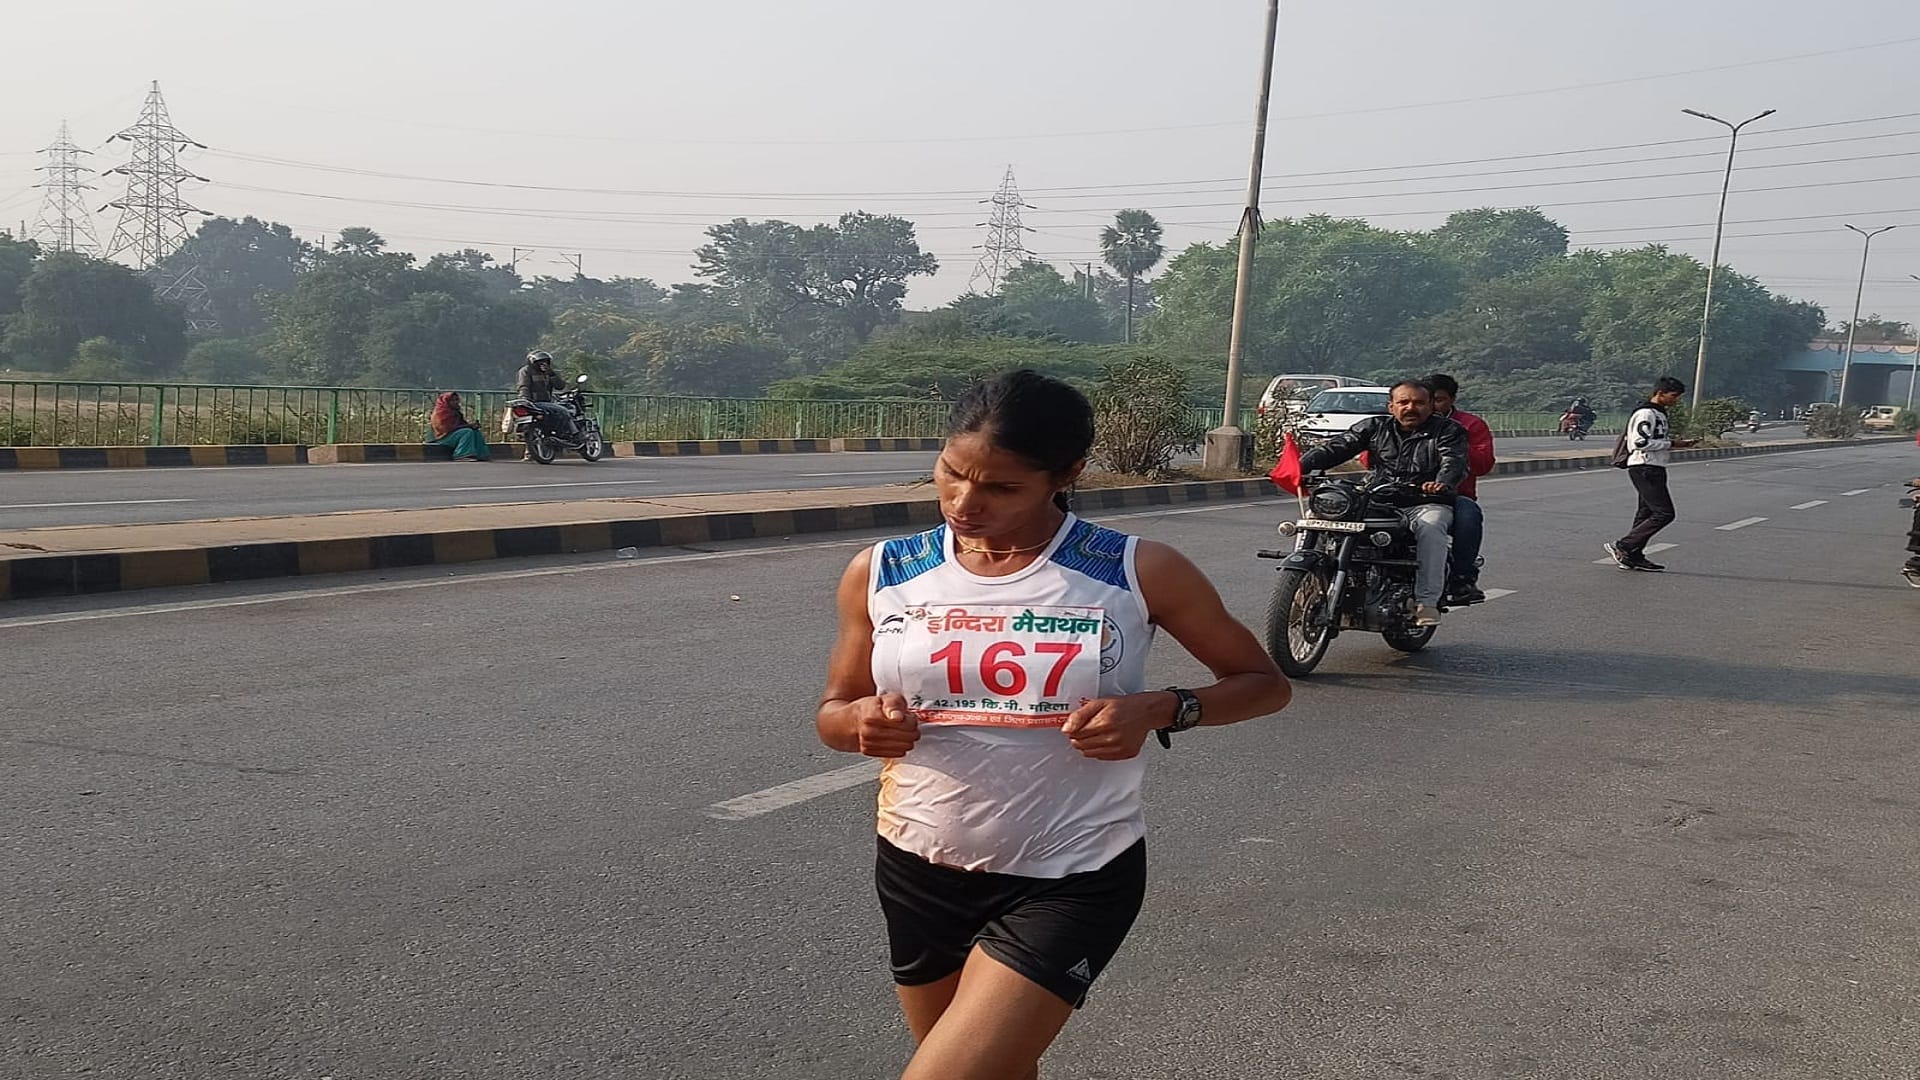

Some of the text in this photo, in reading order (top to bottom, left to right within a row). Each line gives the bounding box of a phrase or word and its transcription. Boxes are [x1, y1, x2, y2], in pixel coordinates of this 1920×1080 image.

[927, 608, 1100, 634] इन्दिरा मैराथन
[930, 640, 1082, 697] 167
[934, 699, 976, 708] 42.195
[1029, 701, 1070, 713] महिला
